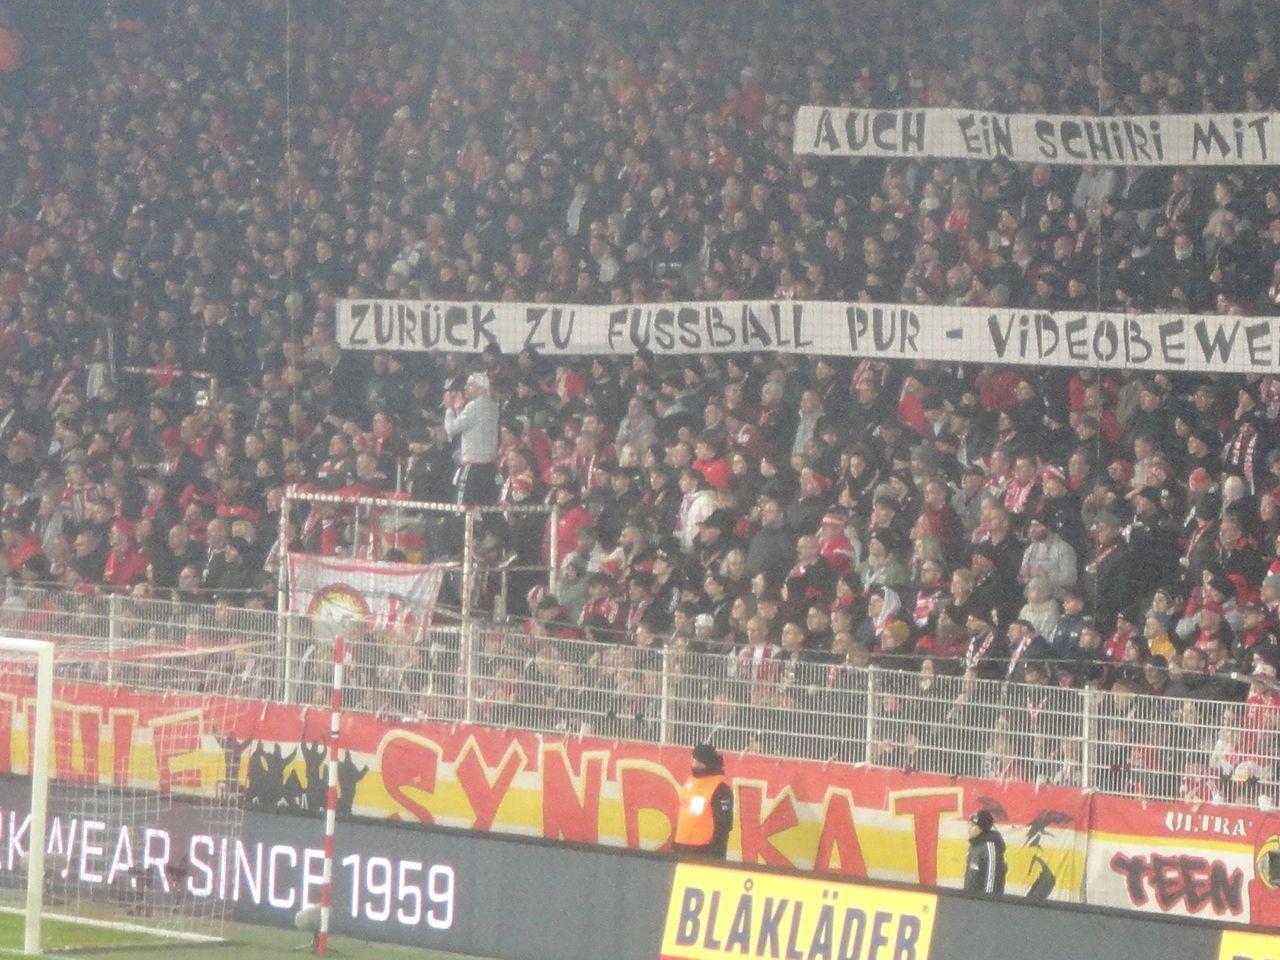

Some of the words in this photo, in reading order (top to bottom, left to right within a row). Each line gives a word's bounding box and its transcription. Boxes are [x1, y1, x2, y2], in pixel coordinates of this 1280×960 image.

[813, 109, 927, 153] AUCH
[350, 303, 502, 348] ZURÜCK
[523, 307, 577, 349] ZU
[607, 304, 814, 351] FUSSBALL
[845, 306, 921, 353] PUR
[377, 730, 964, 887] SYNDKAT
[188, 835, 327, 912] SINCE
[342, 854, 454, 930] 1959
[675, 878, 922, 960] BLÅKLÄDER
[1109, 850, 1244, 917] TEEN
